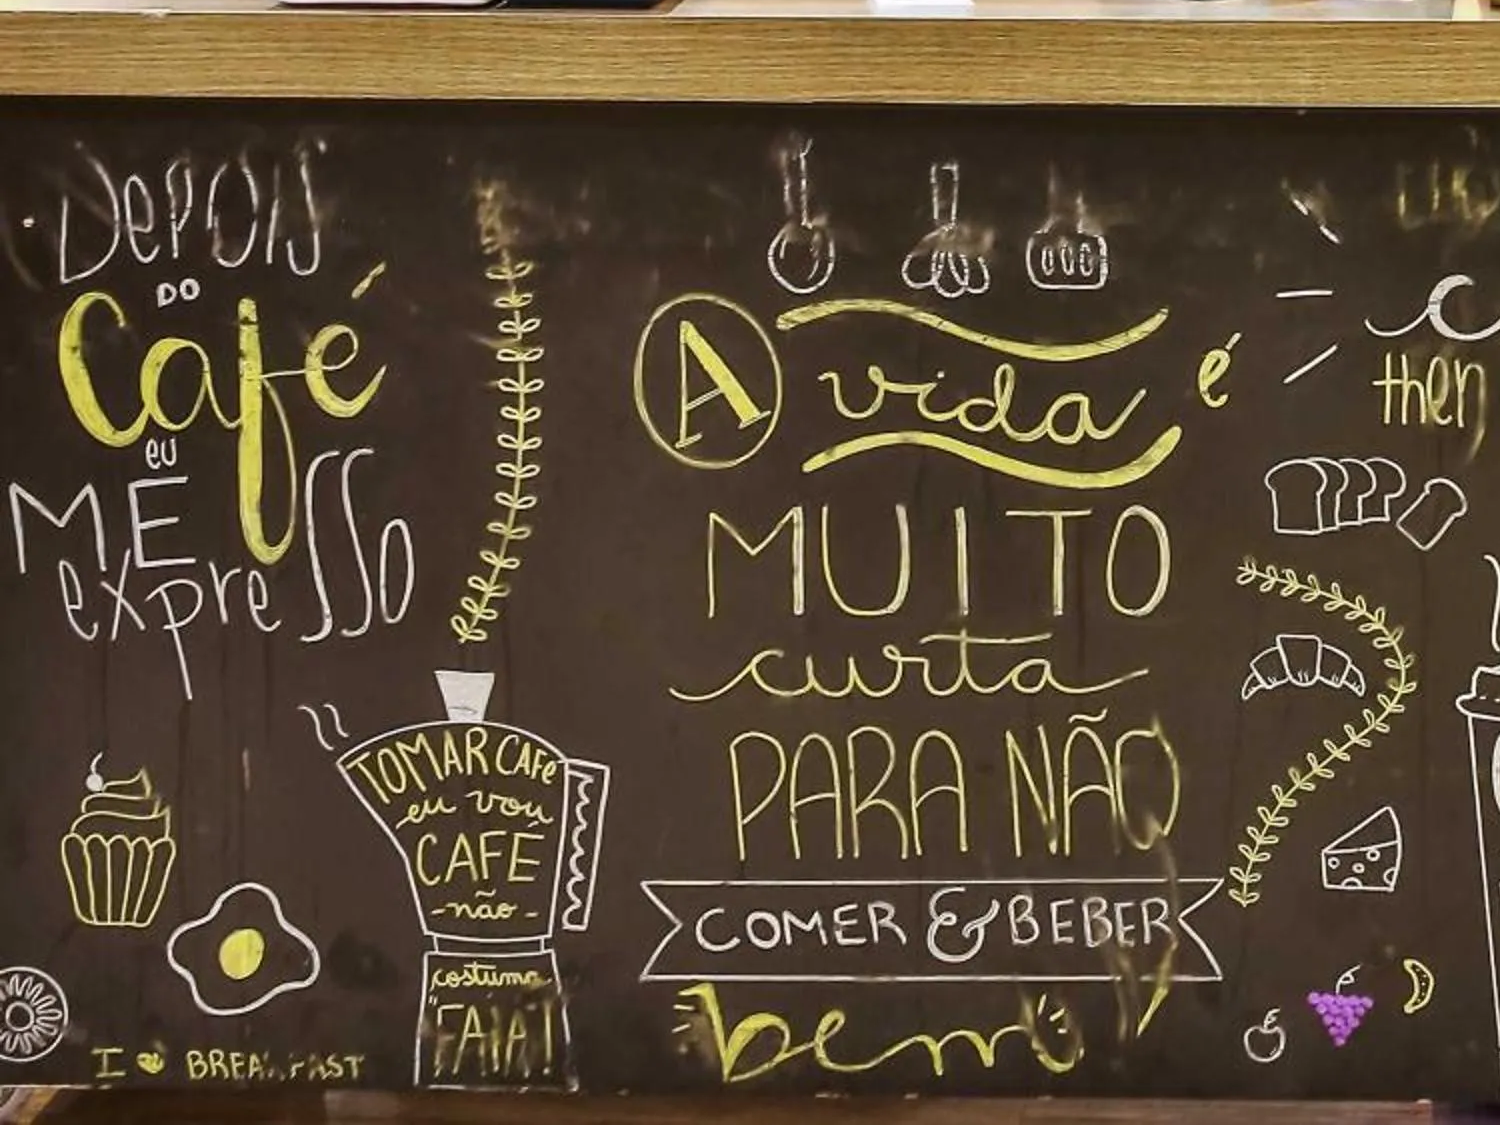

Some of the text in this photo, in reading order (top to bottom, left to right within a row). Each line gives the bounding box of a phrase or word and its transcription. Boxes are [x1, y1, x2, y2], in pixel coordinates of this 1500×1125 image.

[674, 318, 772, 451] A
[817, 362, 1148, 445] vida
[8, 474, 198, 575] ME
[706, 502, 1172, 620] MUITO
[669, 627, 1150, 703] curta
[346, 726, 490, 805] TOMAR
[729, 725, 969, 861] PARA
[694, 901, 907, 953] COMER
[1006, 893, 1177, 949] BEBER
[91, 1047, 127, 1078] I
